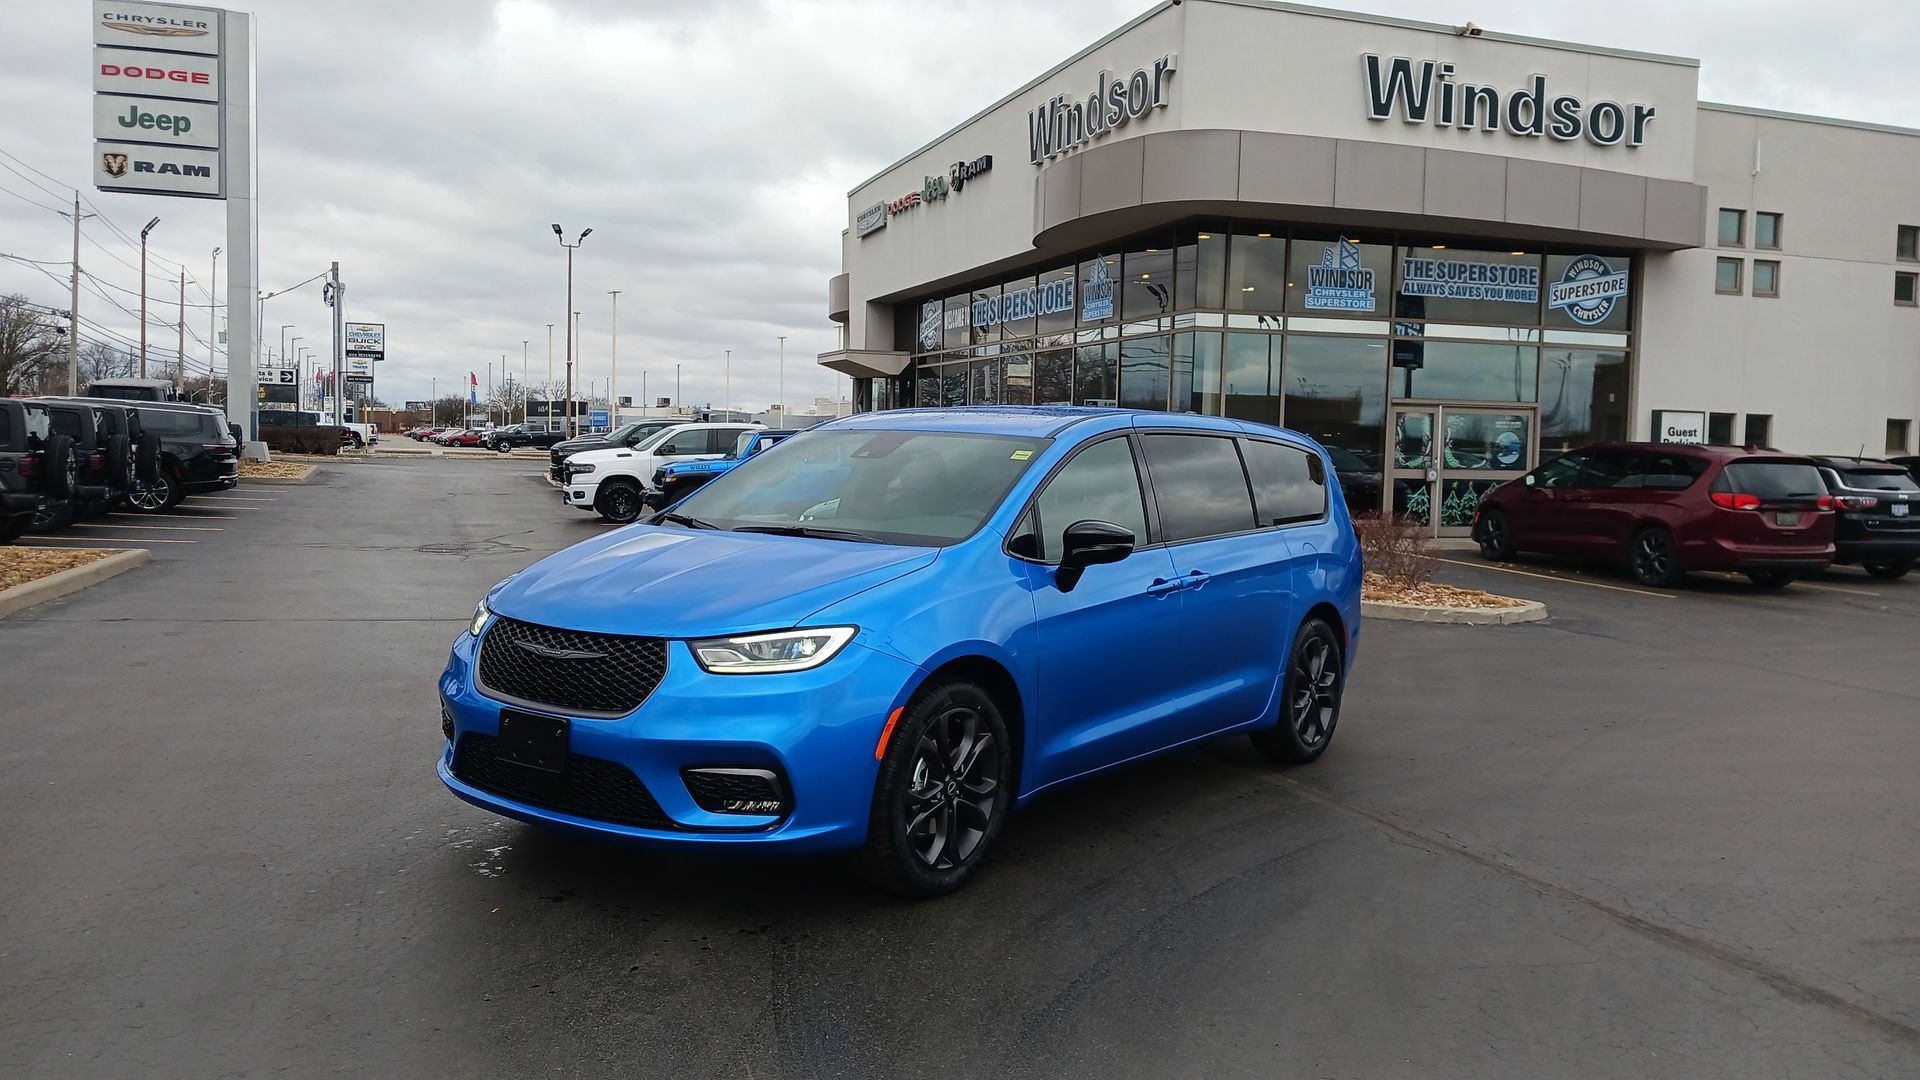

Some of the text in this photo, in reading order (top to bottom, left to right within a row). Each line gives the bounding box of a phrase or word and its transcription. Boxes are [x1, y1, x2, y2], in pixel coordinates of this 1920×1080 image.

[102, 12, 208, 29] CHRYSLER
[101, 64, 210, 84] DODGE
[1027, 52, 1177, 165] Windsor
[1361, 52, 1657, 147] Windsor
[118, 105, 191, 136] Jeep
[134, 160, 211, 178] RAM
[960, 154, 993, 181] RAM
[857, 205, 882, 222] CHRYSLER
[886, 191, 921, 216] DODGE
[1309, 267, 1373, 290] WINDSOR
[1404, 259, 1538, 286] THE SUPERSTORE
[1568, 259, 1605, 278] WINDSOR
[1315, 288, 1366, 299] CHRYSLER
[1403, 281, 1538, 302] ALWAYS SAVES YOU MORE!
[1552, 278, 1625, 302] SUPERSTORE
[972, 301, 987, 326] THE
[988, 277, 1074, 326] SUPERSTORE
[1308, 297, 1373, 309] SUPERSTORE
[1573, 300, 1610, 320] CHRYSLER
[1667, 426, 1698, 438] Guest
